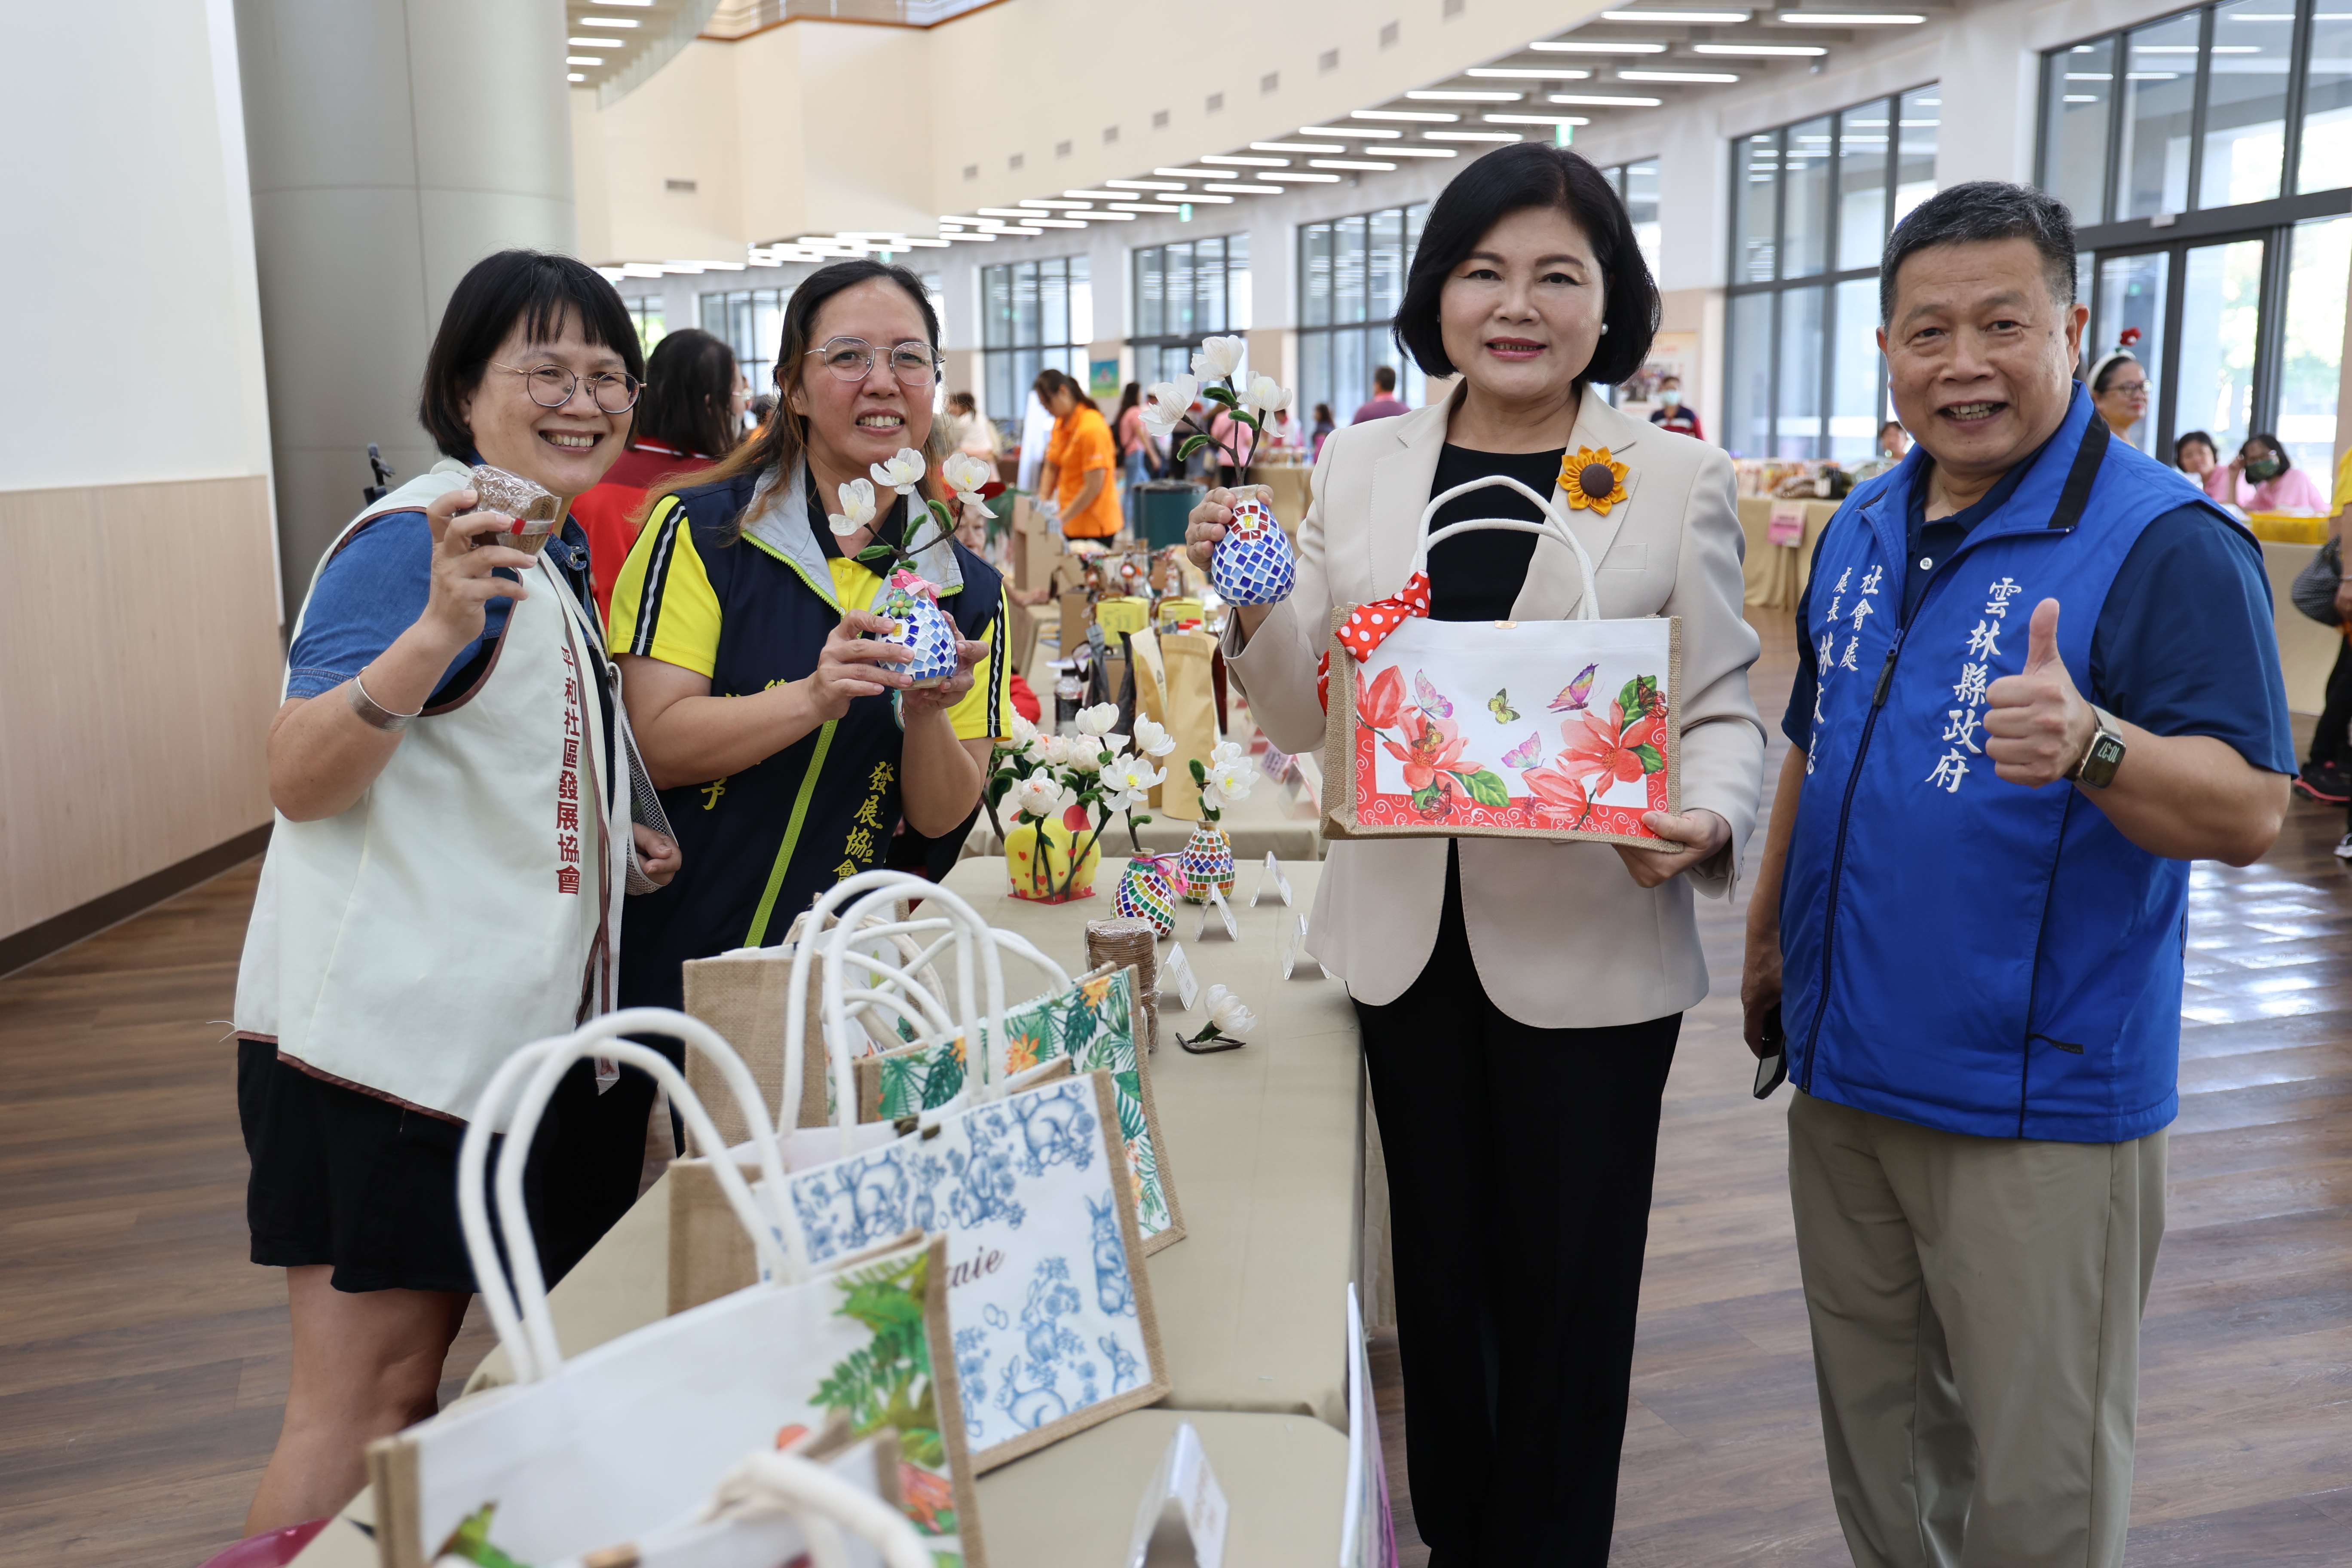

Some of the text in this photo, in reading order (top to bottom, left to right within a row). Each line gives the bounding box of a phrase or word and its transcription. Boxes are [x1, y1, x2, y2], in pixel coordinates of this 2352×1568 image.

[1838, 565, 1883, 672] 社會處
[1924, 577, 2022, 793] 雲林縣政府
[555, 646, 581, 896] 平和社區發展協會
[2097, 741, 2120, 763] 10:37
[832, 761, 894, 884] 發展協會
[946, 1245, 1007, 1290] nie
